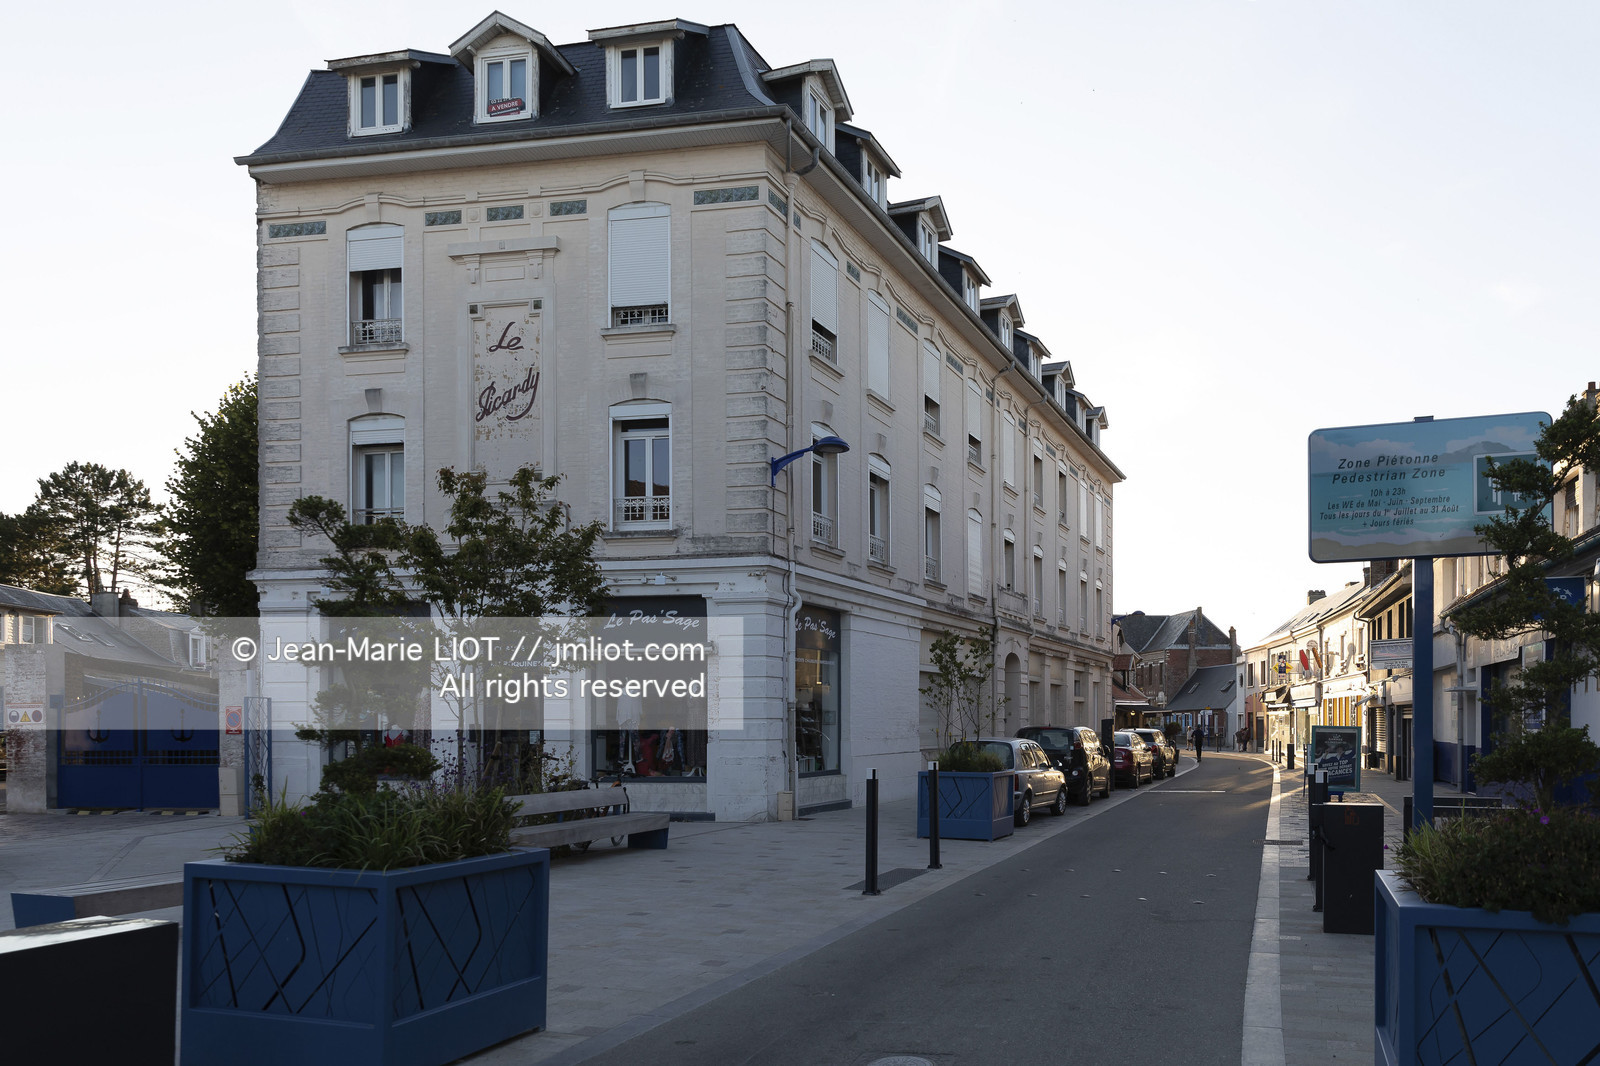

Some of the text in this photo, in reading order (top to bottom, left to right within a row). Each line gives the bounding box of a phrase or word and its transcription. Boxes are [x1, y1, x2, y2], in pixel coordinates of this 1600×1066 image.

[497, 100, 519, 111] VENDRE
[488, 321, 524, 352] Le
[1338, 453, 1439, 470] Zone Piétonne
[1332, 467, 1446, 484] Pedestrian Zone
[1370, 487, 1406, 497] 10h à 23h
[1327, 502, 1340, 510] Les
[1342, 500, 1354, 509] WE
[1356, 499, 1365, 508] de
[1367, 499, 1381, 507] Mai
[1387, 498, 1403, 506] Juin
[1410, 495, 1451, 506] Septembre
[1320, 512, 1337, 520] Tous
[1338, 510, 1349, 519] les
[1351, 511, 1370, 520] jours
[1372, 509, 1382, 517] du
[1393, 507, 1417, 516] Juillet
[1430, 505, 1439, 514] 31
[1441, 504, 1459, 513] Août
[1369, 519, 1390, 527] Jours
[1392, 517, 1414, 526] fériés
[603, 609, 700, 631] Le Pas'Sage
[804, 616, 836, 640] Pas'Sage
[1327, 768, 1352, 776] ACANCES
